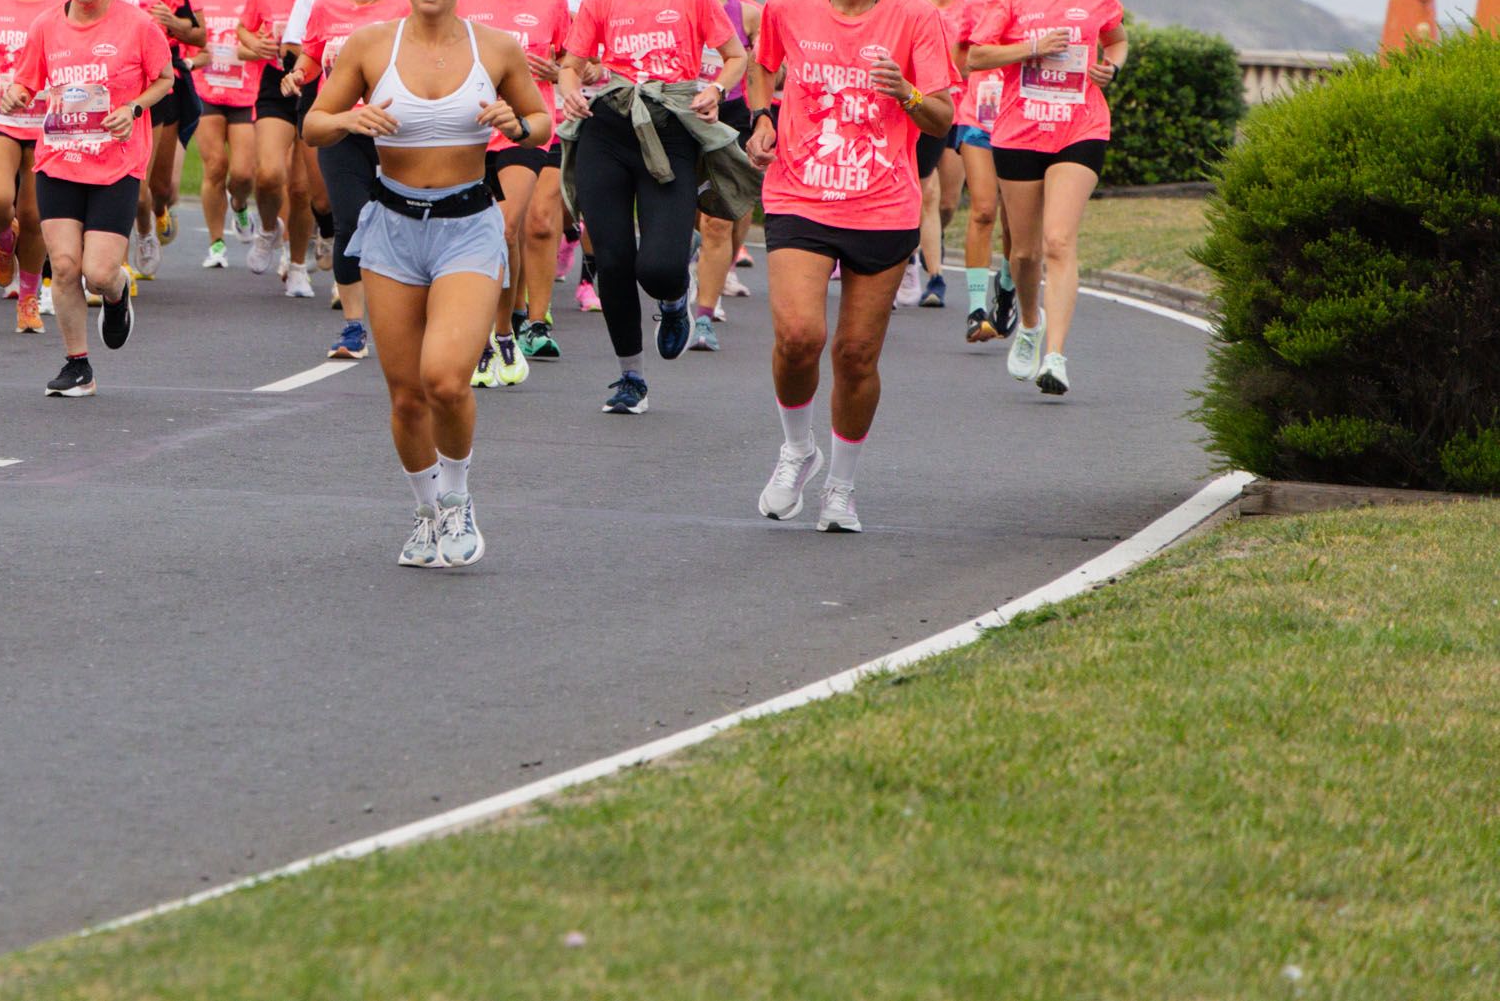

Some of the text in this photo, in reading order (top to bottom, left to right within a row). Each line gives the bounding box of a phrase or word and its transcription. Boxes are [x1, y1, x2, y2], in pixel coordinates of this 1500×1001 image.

[614, 30, 677, 54] CARRERA
[800, 39, 834, 52] OYSHO
[51, 63, 109, 86] CARRERA
[211, 63, 230, 73] 016
[702, 63, 717, 74] 16
[1041, 69, 1067, 81] 016
[842, 95, 865, 124] DE
[1023, 102, 1072, 122] MUJER
[62, 112, 88, 124] 016
[63, 152, 82, 163] 2026
[837, 139, 858, 167] LA
[803, 161, 869, 191] MUJER
